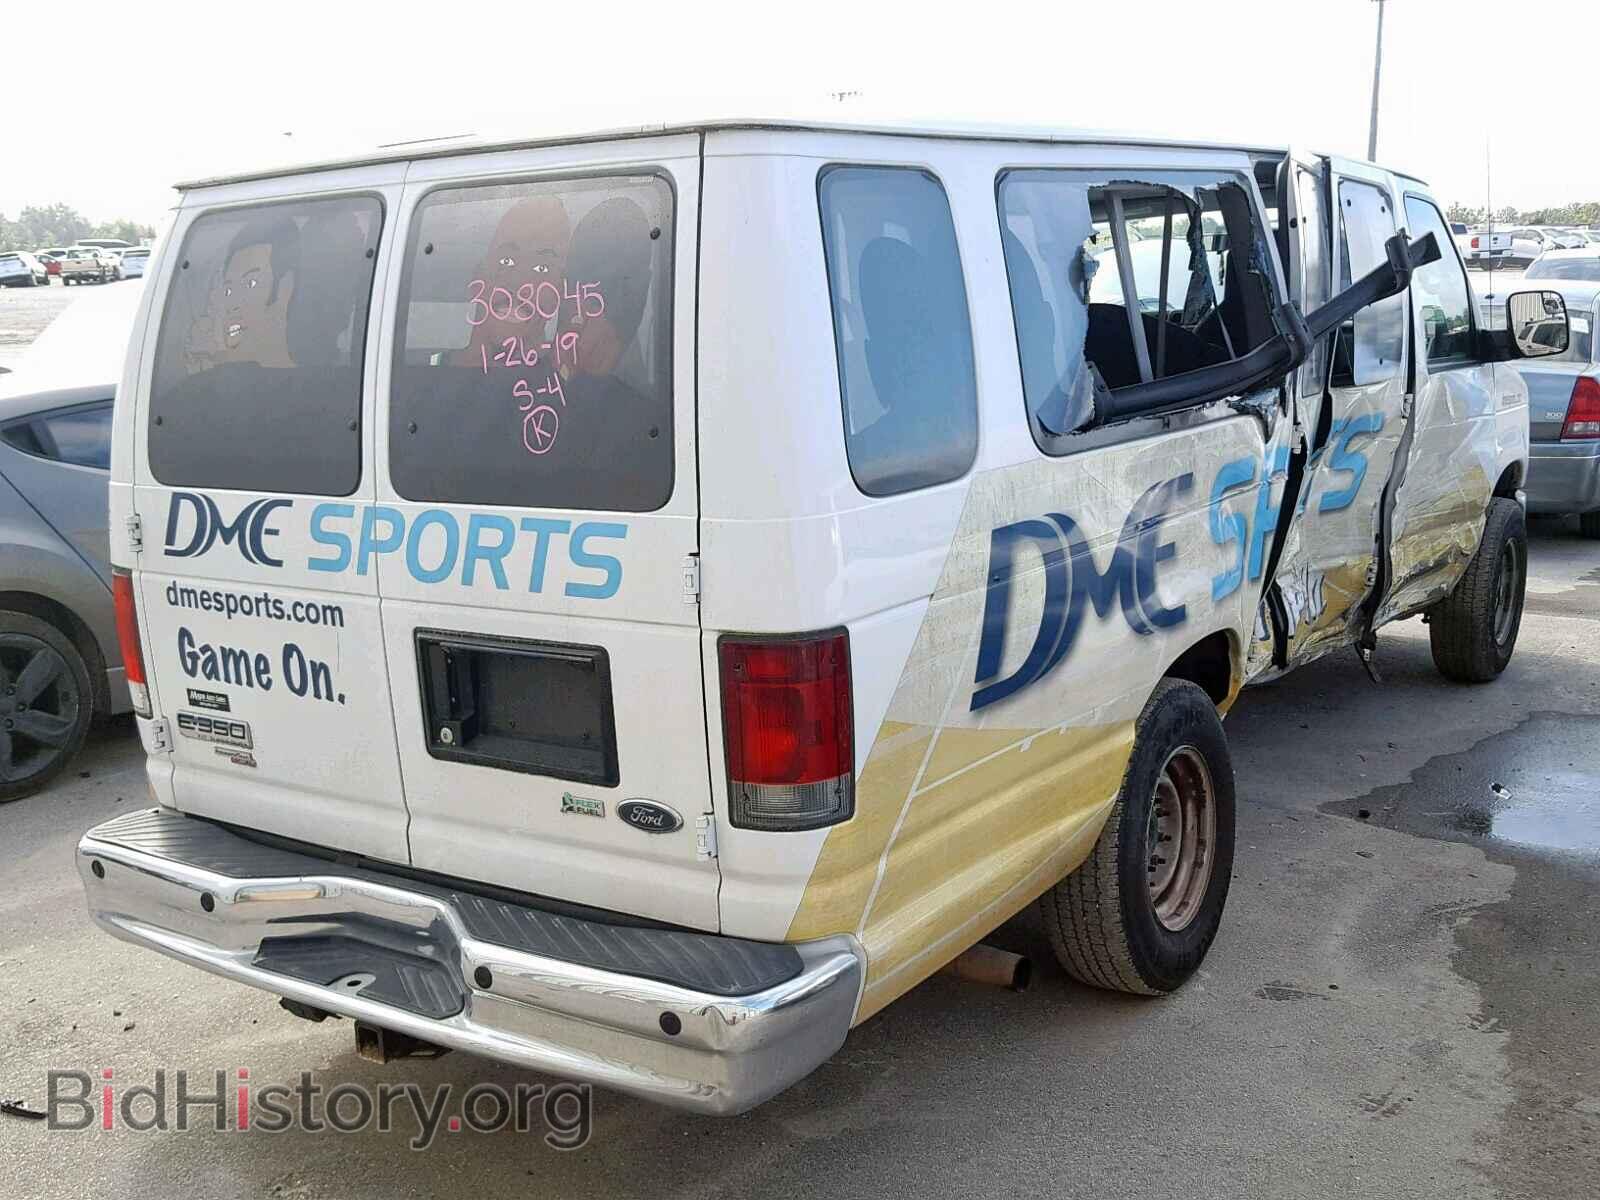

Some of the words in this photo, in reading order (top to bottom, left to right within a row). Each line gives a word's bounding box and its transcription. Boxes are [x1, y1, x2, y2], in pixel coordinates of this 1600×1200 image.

[466, 278, 605, 326] 308045
[480, 331, 580, 375] 1-26-19
[164, 492, 293, 567] DME
[307, 505, 628, 600] SPORTS
[166, 580, 344, 628] dmesports.com
[969, 472, 1194, 712] DME
[177, 626, 273, 692] Game
[281, 642, 346, 705] On.
[630, 805, 664, 827] Ford
